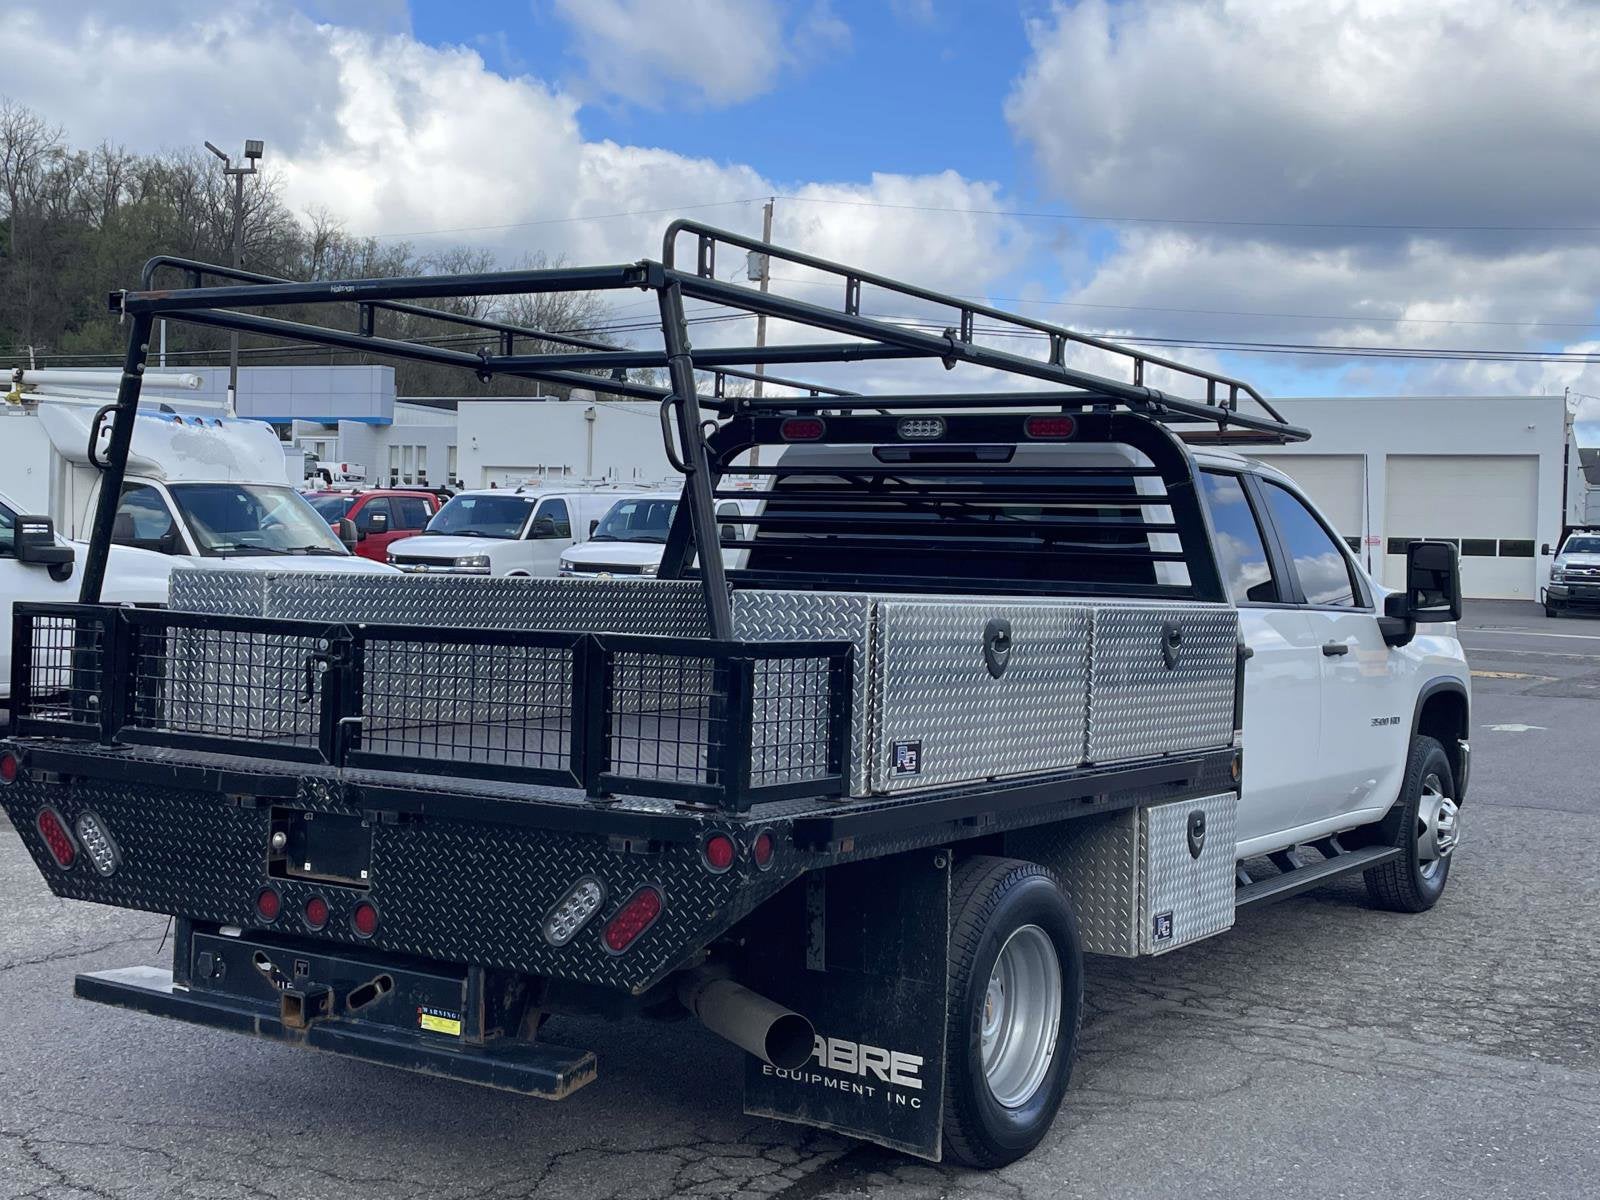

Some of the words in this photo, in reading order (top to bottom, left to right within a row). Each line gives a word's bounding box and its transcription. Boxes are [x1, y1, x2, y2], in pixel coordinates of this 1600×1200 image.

[1370, 717, 1389, 727] 3500
[813, 1033, 924, 1089] ABRE
[762, 1064, 876, 1097] EQUIPMENT
[887, 1092, 921, 1109] INC
